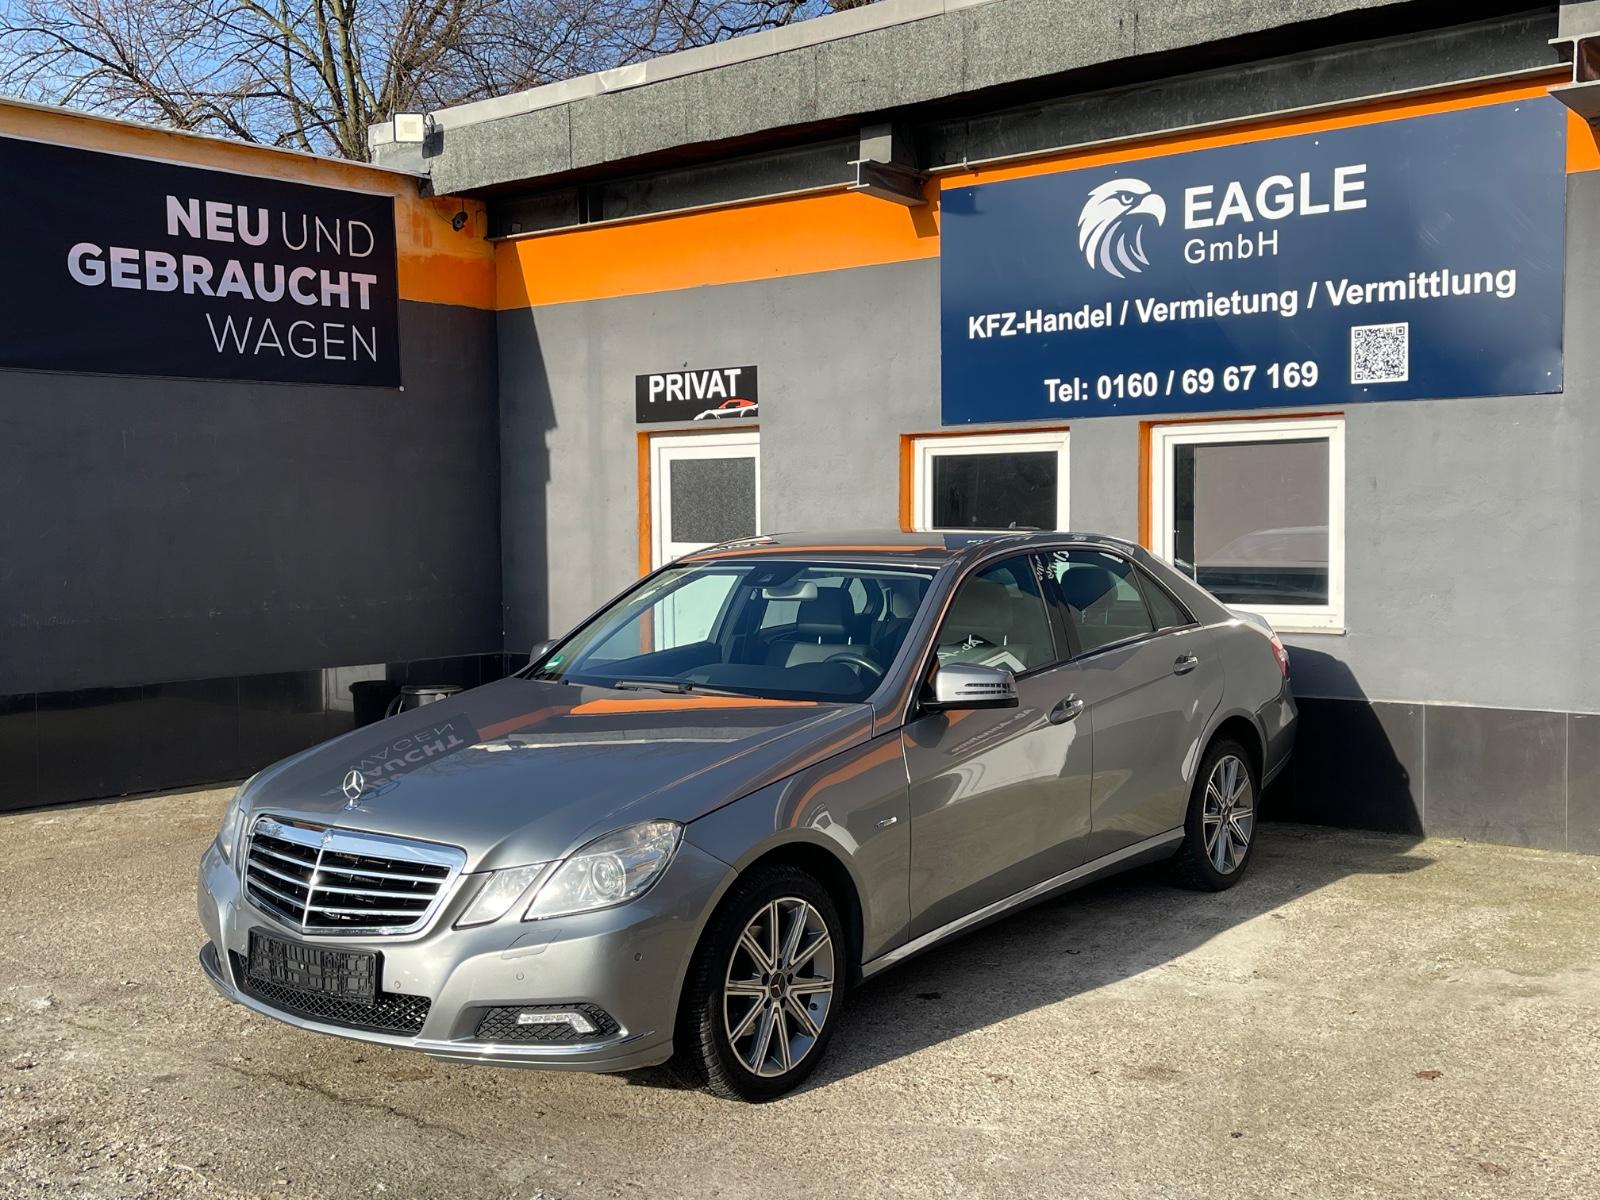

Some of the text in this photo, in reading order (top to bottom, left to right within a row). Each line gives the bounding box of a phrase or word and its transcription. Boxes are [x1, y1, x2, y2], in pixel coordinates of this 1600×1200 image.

[1184, 163, 1367, 230] EAGLE
[166, 195, 375, 258] NEU UND
[1184, 229, 1278, 264] GmbH
[67, 242, 377, 310] GEBRAUCHT
[968, 268, 1518, 339] KFZ-Handel / Vermietung / Vermittlung
[205, 313, 377, 362] WAGEN
[648, 368, 742, 403] PRIVAT
[1044, 360, 1319, 403] Tel: 0160 / 69 67 169
